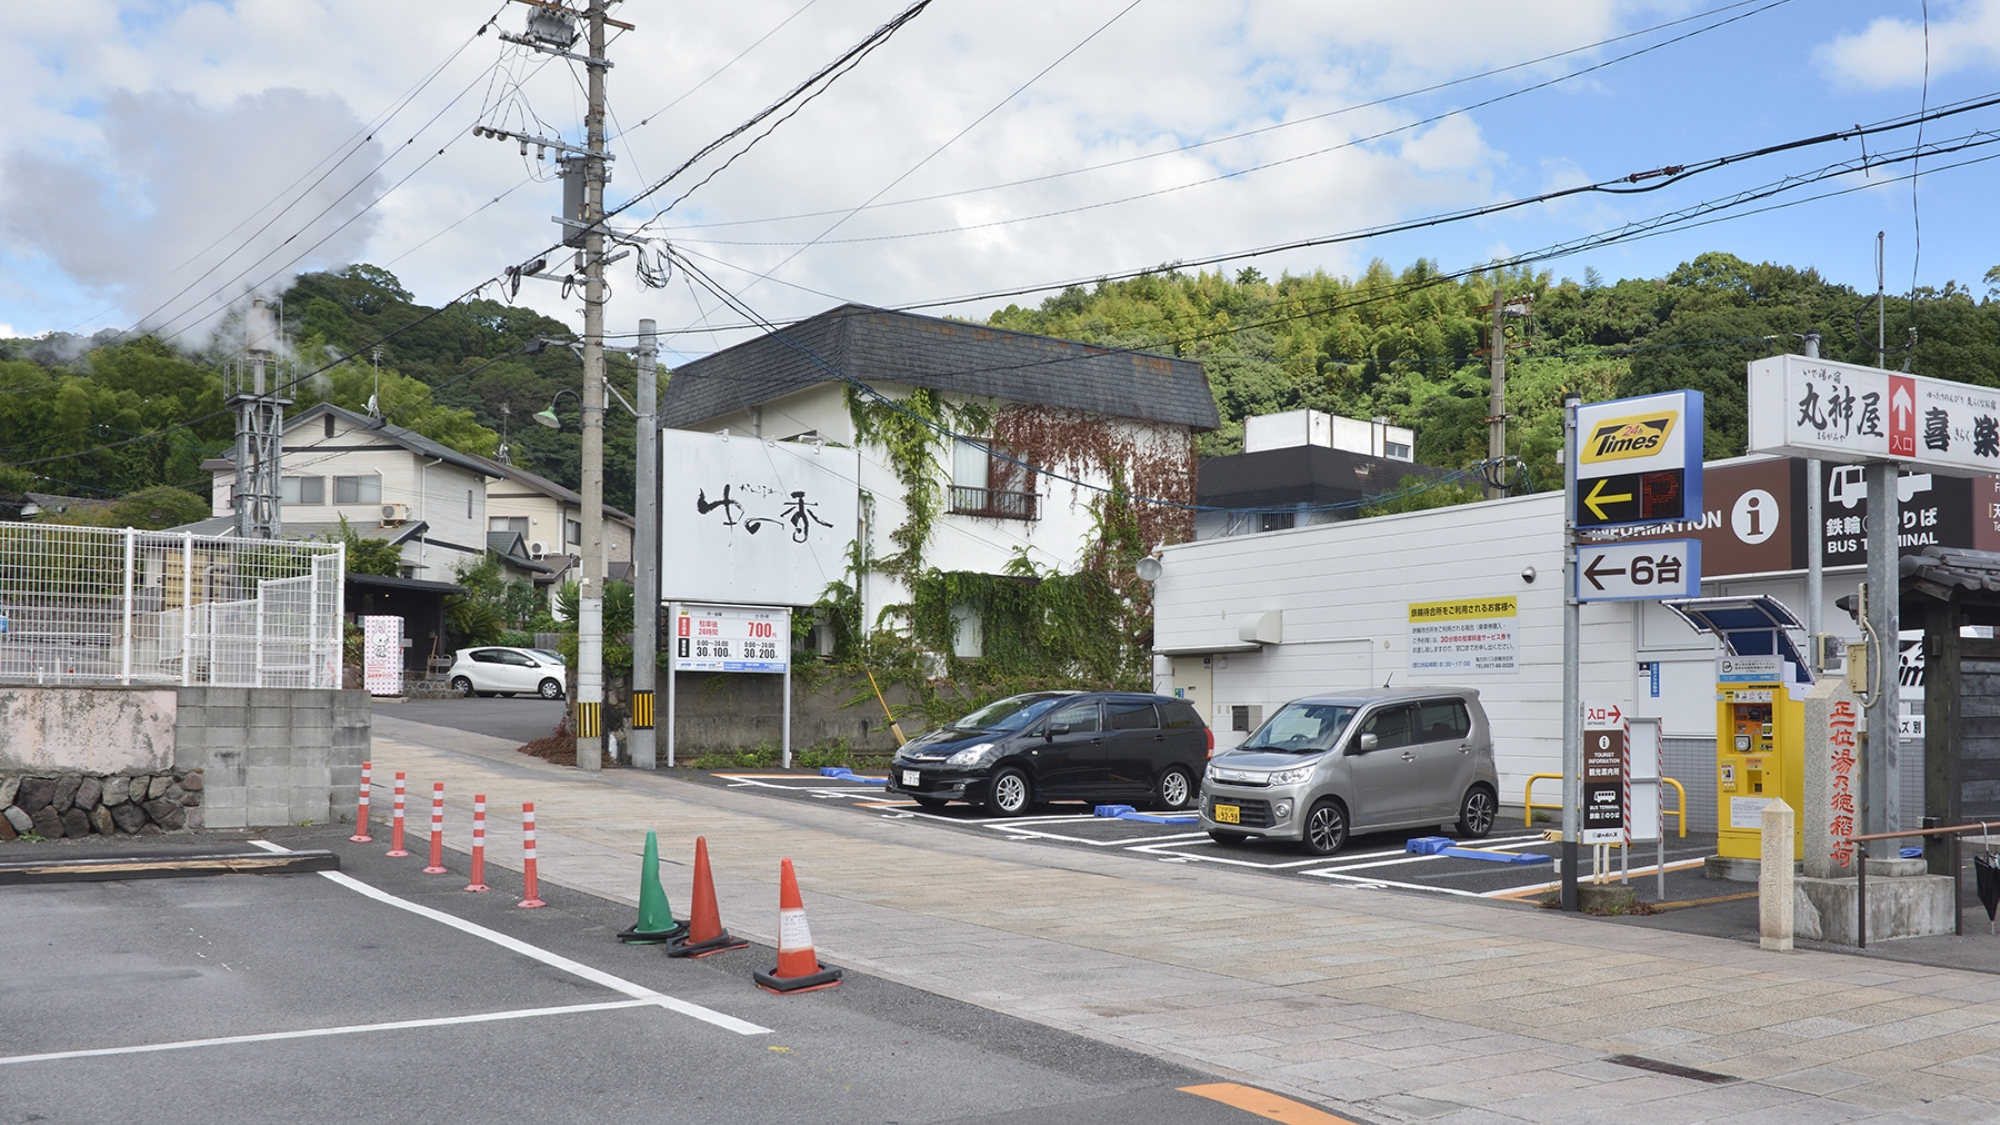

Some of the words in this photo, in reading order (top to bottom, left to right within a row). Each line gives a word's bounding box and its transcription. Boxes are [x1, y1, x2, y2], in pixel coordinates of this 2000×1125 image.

[1797, 382, 1884, 438] 丸神屋
[1622, 424, 1643, 437] 24h
[1595, 434, 1660, 457] Times
[1892, 434, 1913, 452] 入口
[1828, 540, 1857, 554] BUS
[1861, 532, 1939, 551] TINAL
[1630, 555, 1682, 585] 6台
[1587, 708, 1606, 720] 入口
[1588, 767, 1620, 776] 観光案内所
